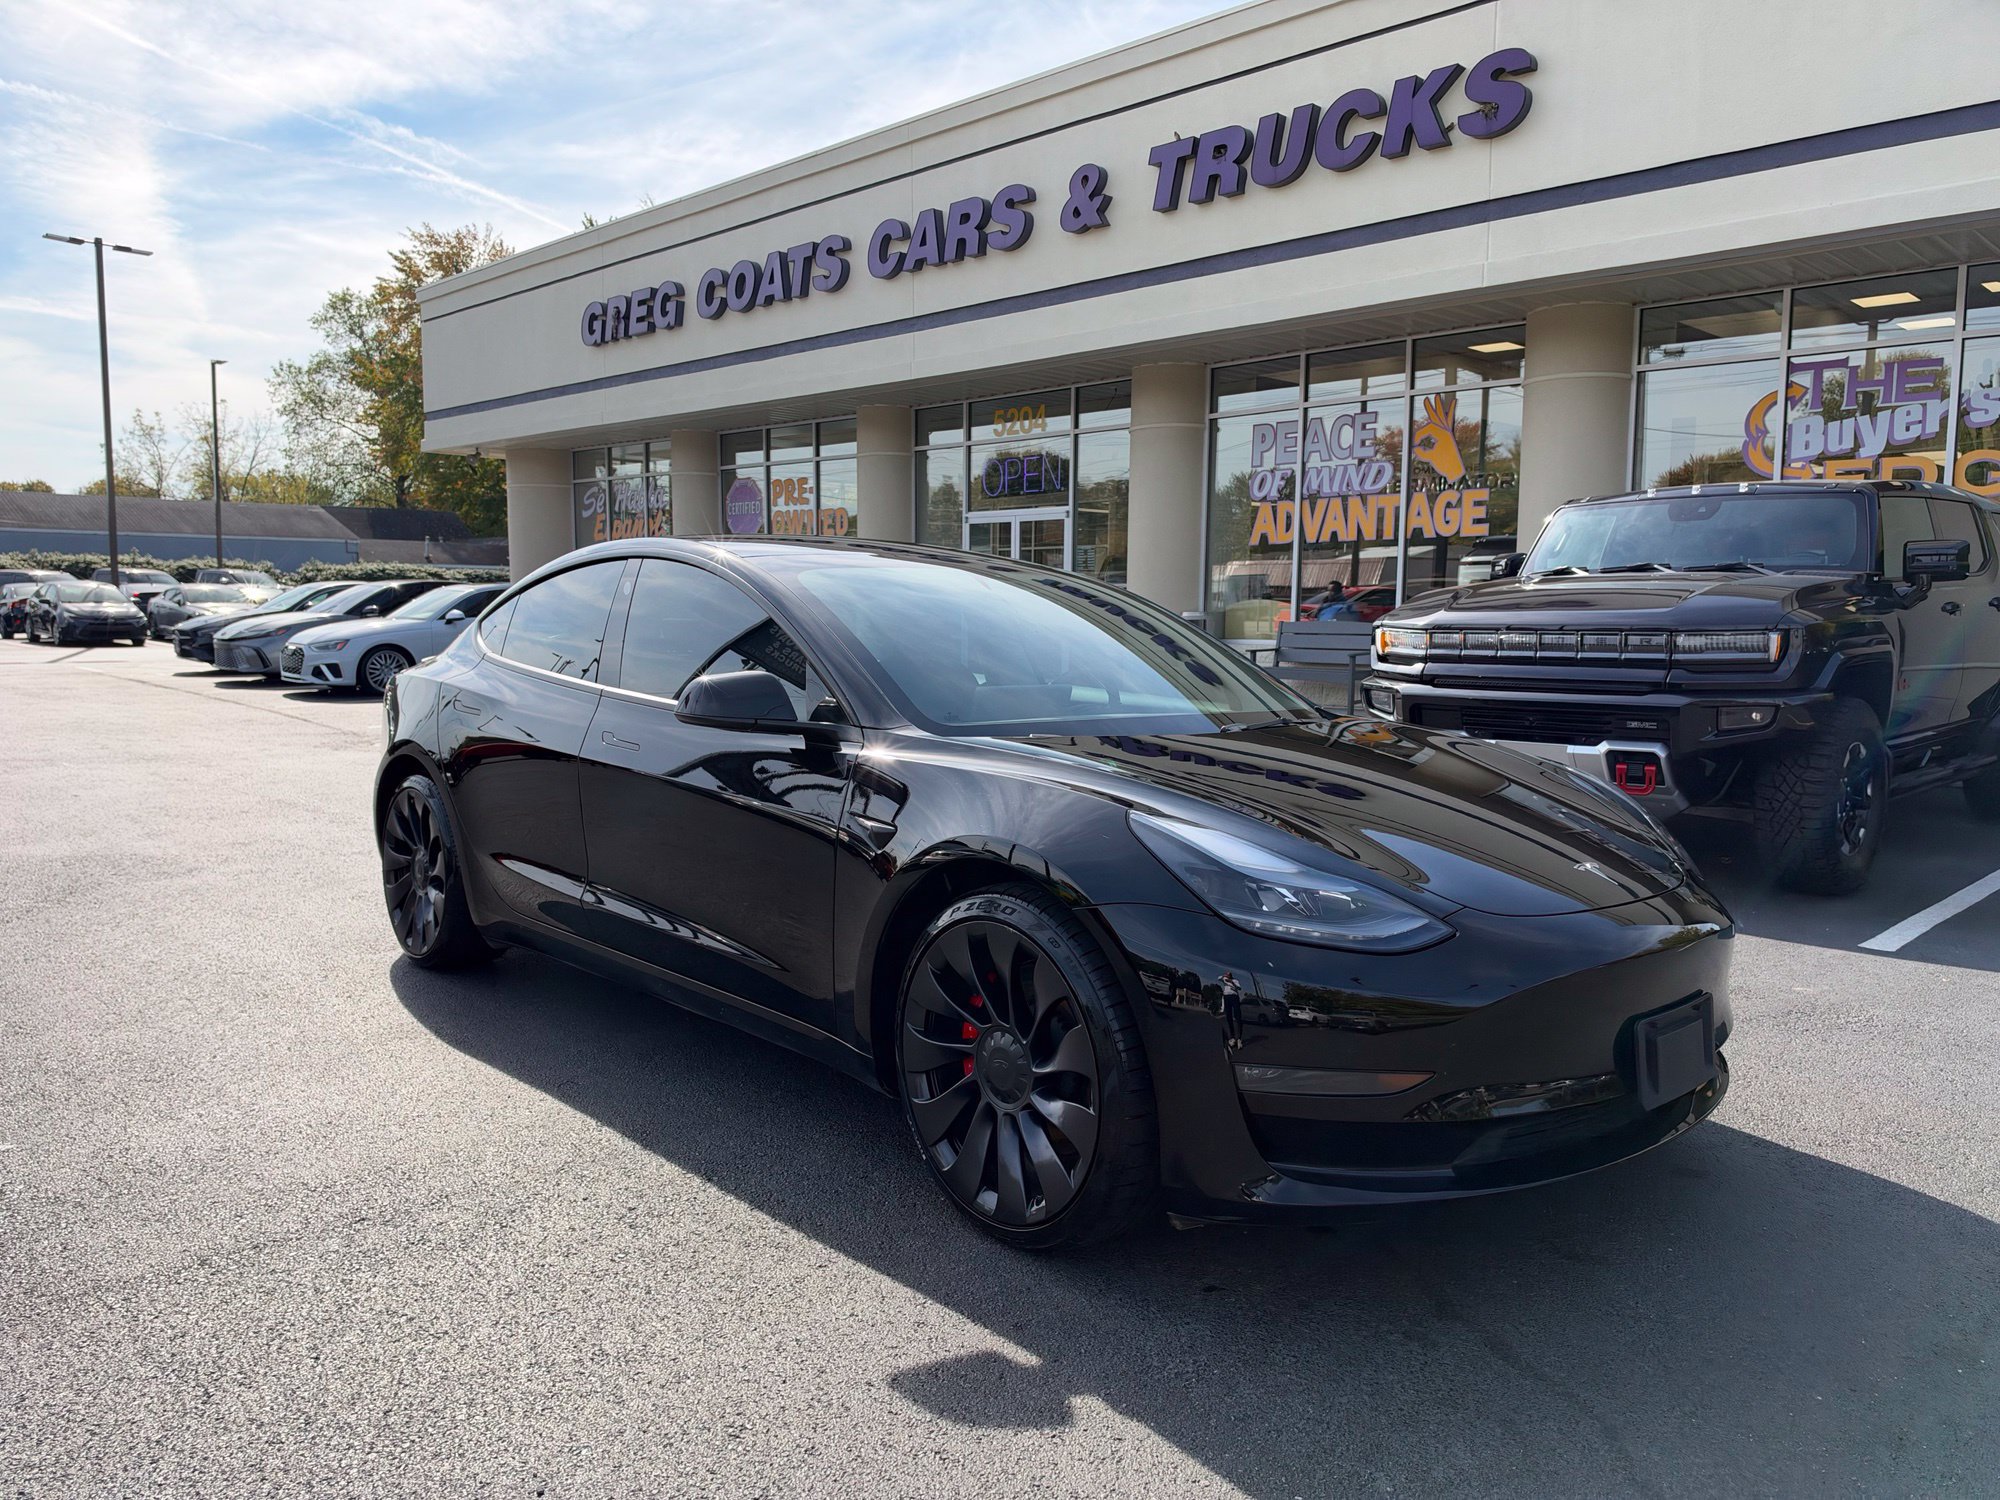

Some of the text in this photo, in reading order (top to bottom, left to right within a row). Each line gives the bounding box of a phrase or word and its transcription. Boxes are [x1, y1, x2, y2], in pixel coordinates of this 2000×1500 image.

[581, 47, 1538, 347] GREG COATS CARS & TRUCKS
[1790, 356, 1944, 412] THE
[993, 404, 1048, 437] 5204
[1251, 411, 1379, 468] PEACE
[772, 477, 814, 507] PRE-
[982, 454, 1062, 497] OPEN
[1250, 461, 1395, 500] OF MIND
[728, 500, 760, 516] CERTIFIED
[771, 507, 849, 536] OWNED
[1249, 487, 1490, 546] ADVANTAGE
[1626, 720, 1658, 729] GMC
[963, 899, 1018, 917] ZERO
